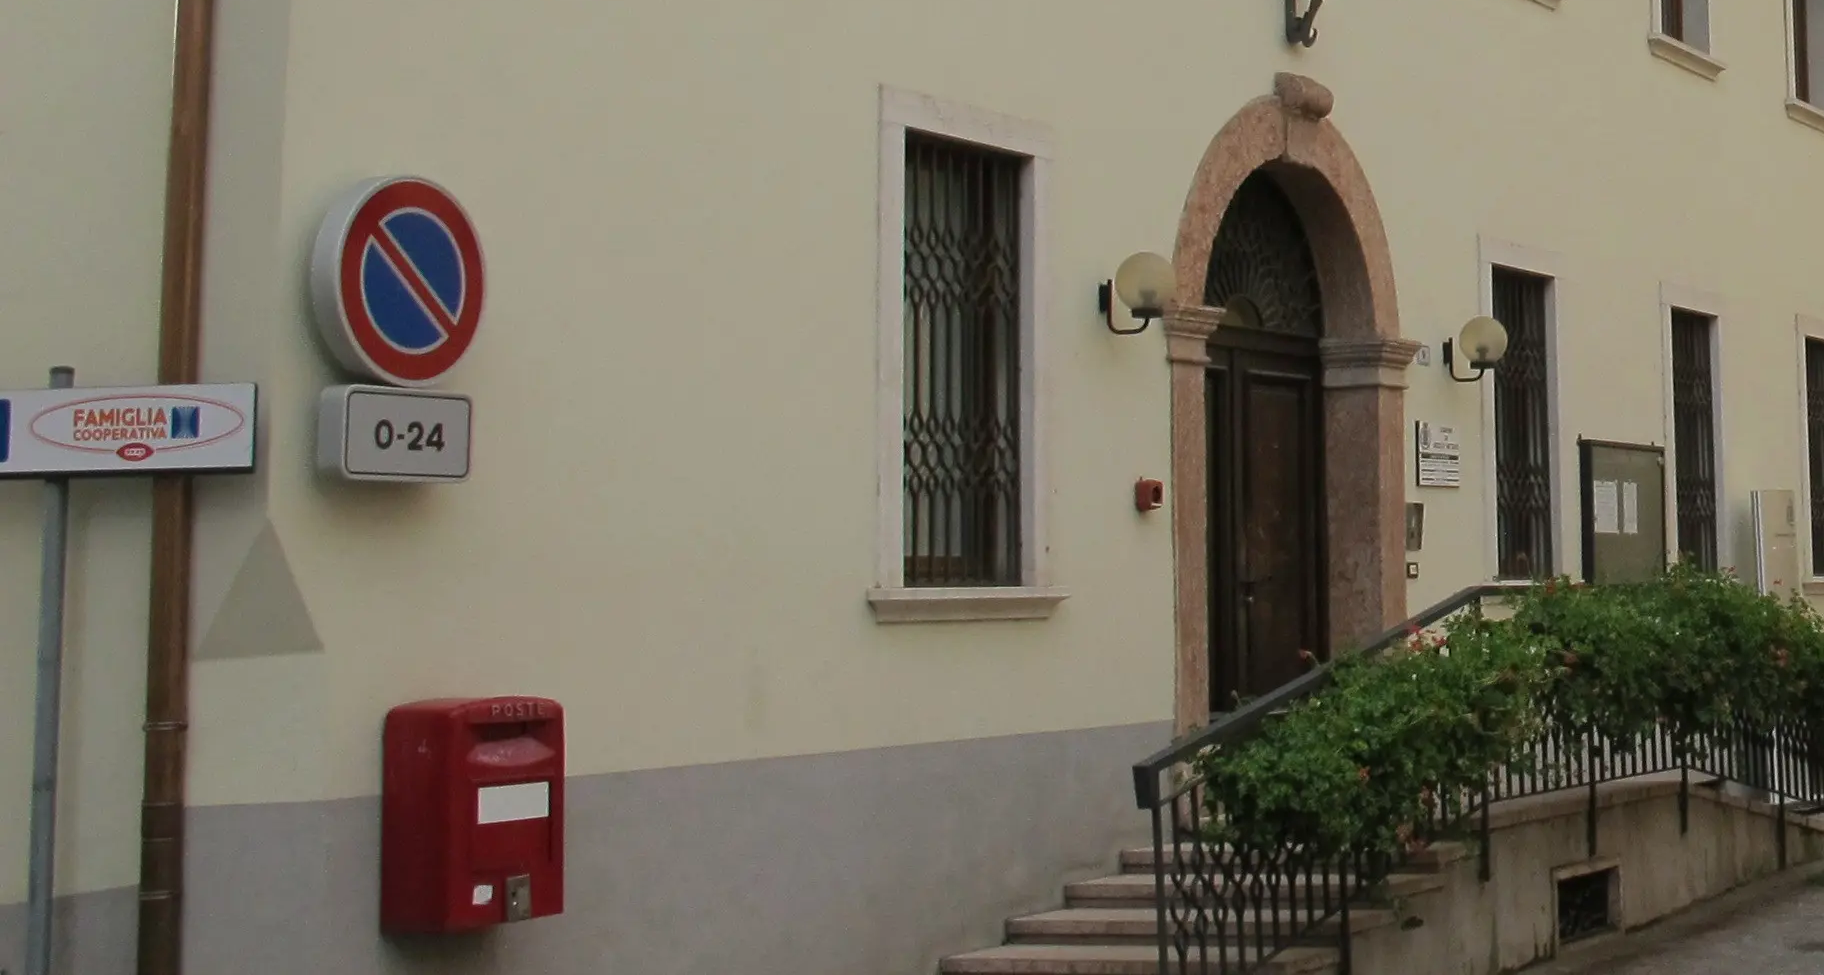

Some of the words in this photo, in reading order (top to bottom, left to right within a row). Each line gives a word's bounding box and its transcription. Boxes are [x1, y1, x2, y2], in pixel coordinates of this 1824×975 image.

[73, 407, 168, 427] FAMIGLIA
[73, 426, 168, 442] COOPERATIVA
[374, 419, 445, 452] 0-24
[491, 702, 545, 717] POSTE
